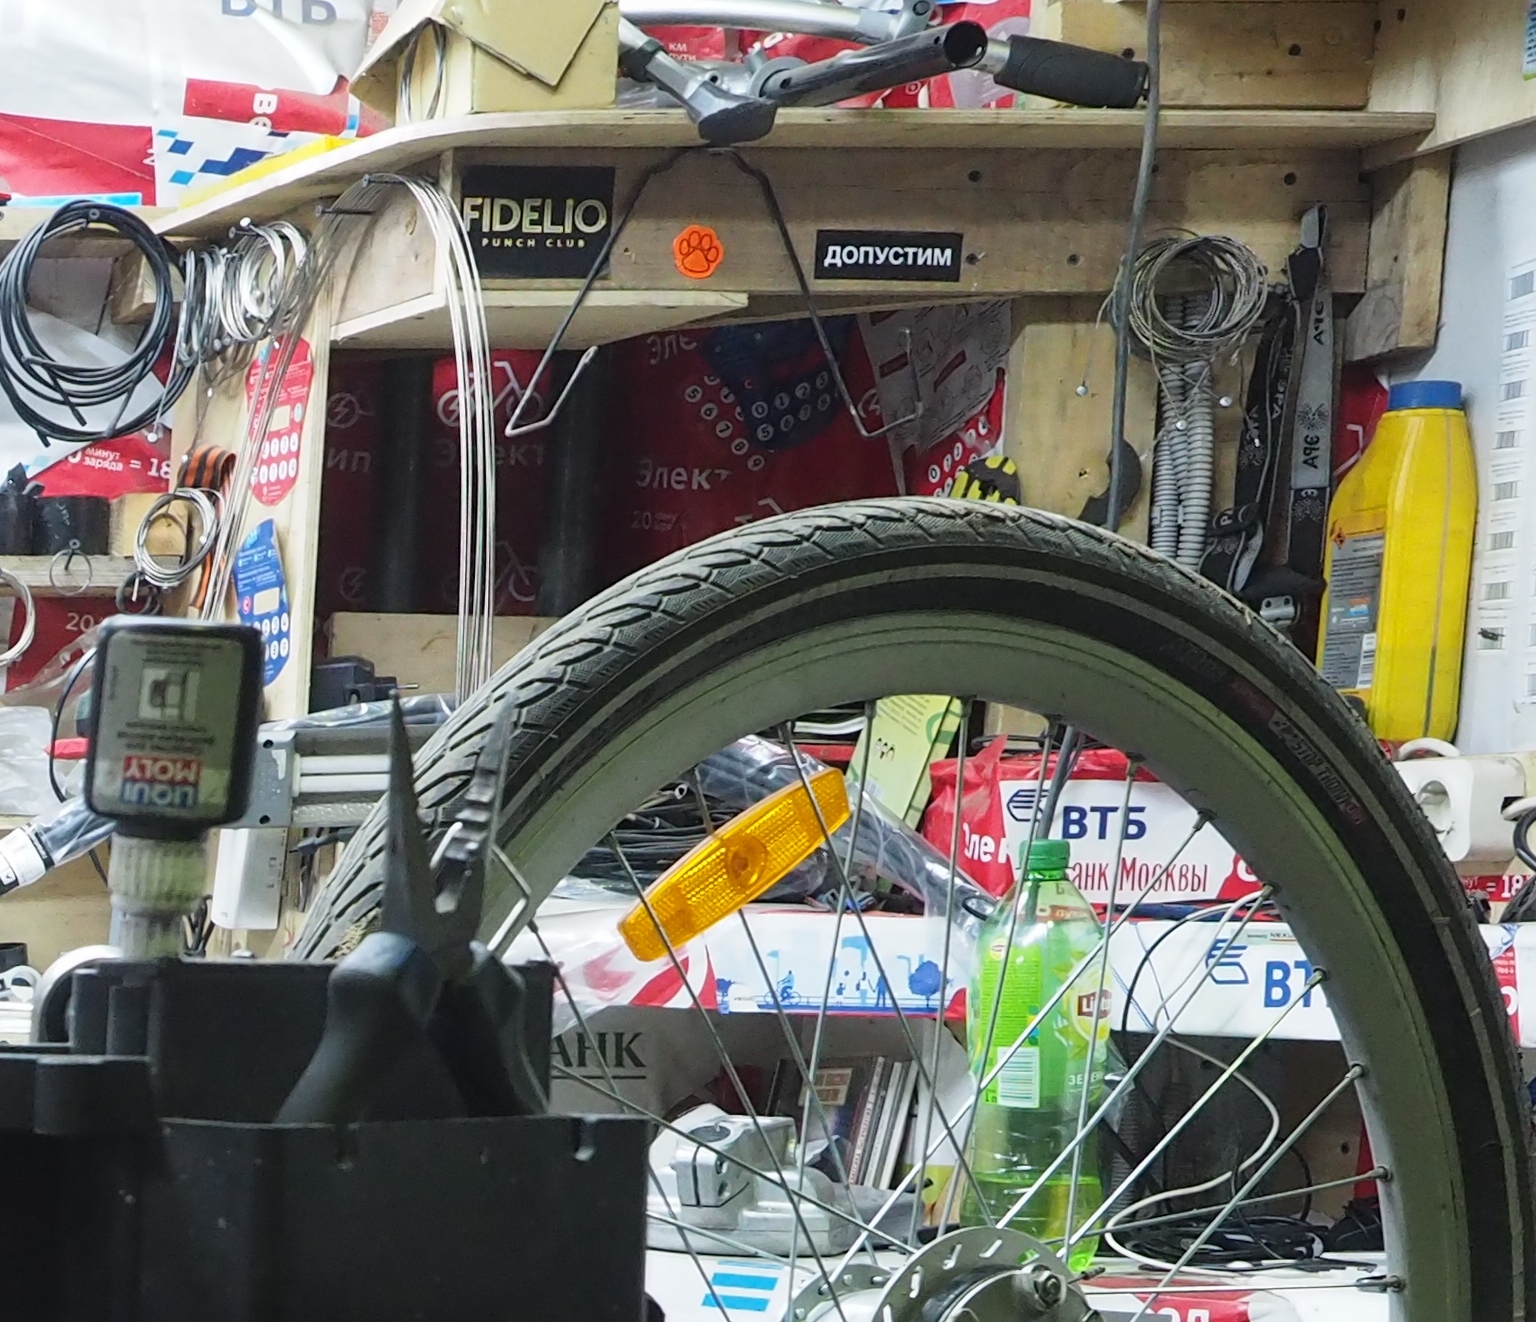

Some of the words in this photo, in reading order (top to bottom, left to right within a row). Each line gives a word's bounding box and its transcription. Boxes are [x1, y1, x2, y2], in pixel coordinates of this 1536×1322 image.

[463, 197, 607, 235] FIDELIO
[481, 238, 536, 249] PUNCH
[545, 238, 586, 249] CLUB
[824, 244, 953, 268] ДОПУСТИМ
[82, 457, 124, 473] заряда
[84, 447, 121, 461] минут
[149, 457, 170, 479] 18
[124, 758, 197, 782] MOLY
[1062, 805, 1147, 840] ВТБ
[1119, 857, 1208, 893] Москвы
